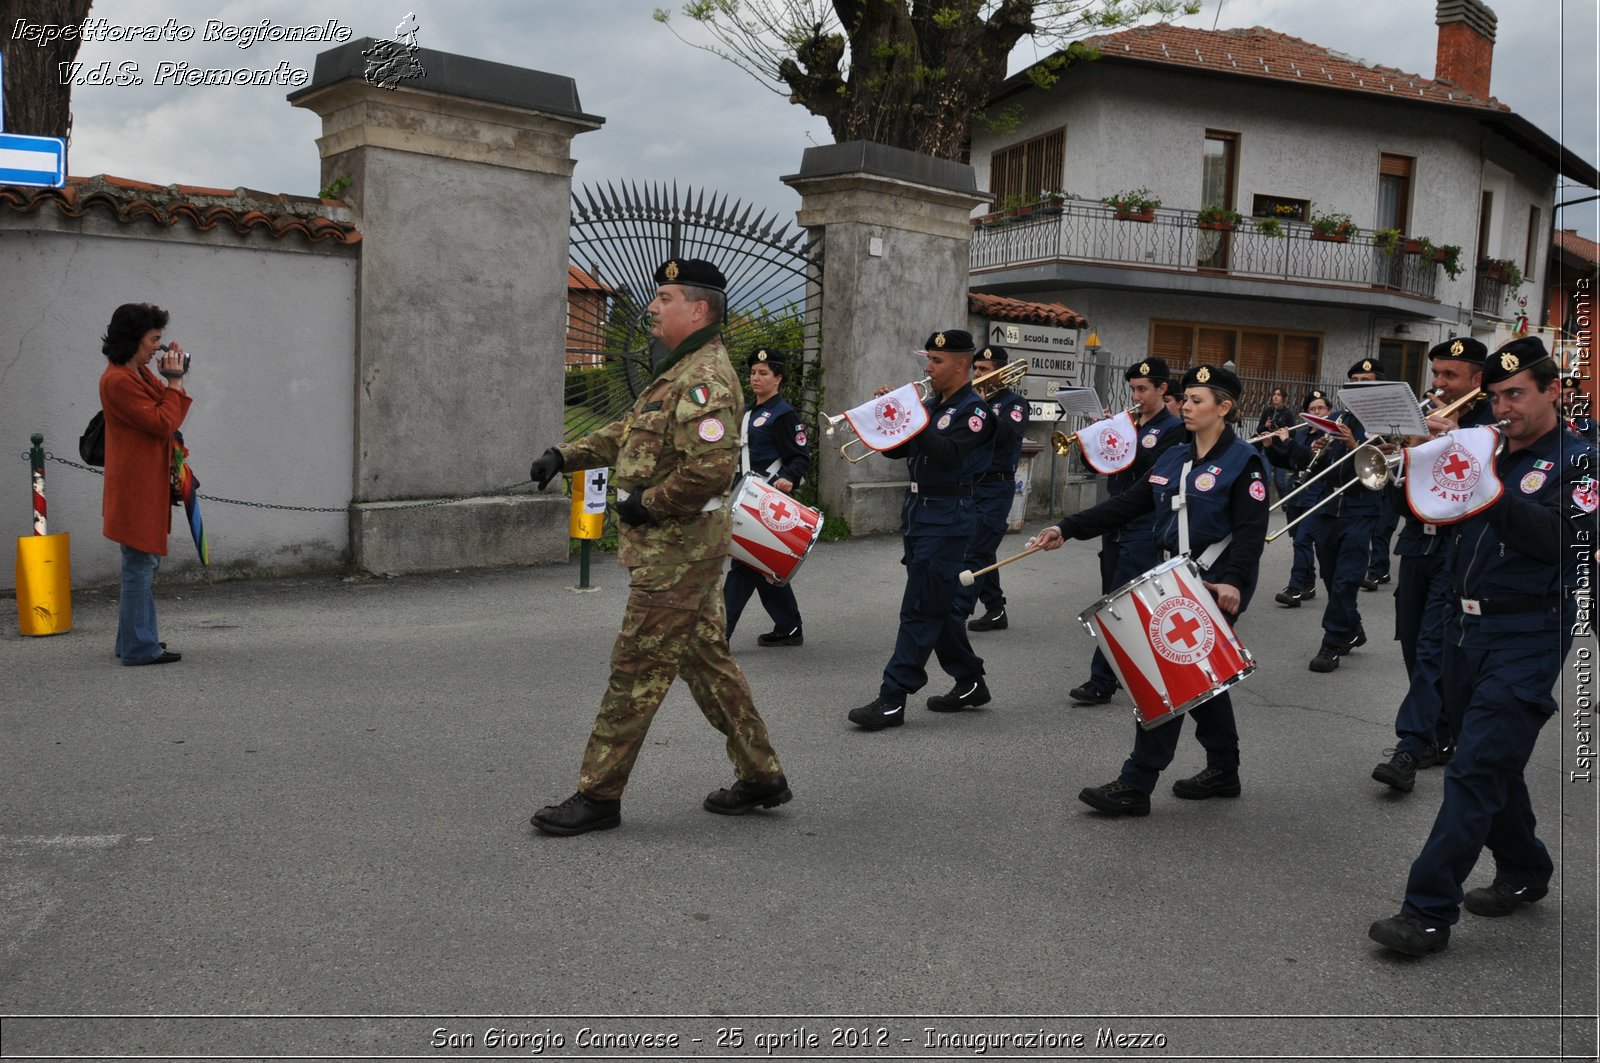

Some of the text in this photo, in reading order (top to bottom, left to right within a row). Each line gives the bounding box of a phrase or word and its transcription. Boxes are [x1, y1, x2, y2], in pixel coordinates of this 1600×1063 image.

[1023, 334, 1075, 346] scuola media
[1031, 357, 1075, 371] FALCONIERI
[1157, 598, 1186, 616] GINEVRA
[1151, 614, 1161, 626] DI
[1194, 606, 1214, 635] AGOSTO
[1151, 626, 1193, 663] CONVENZIONE
